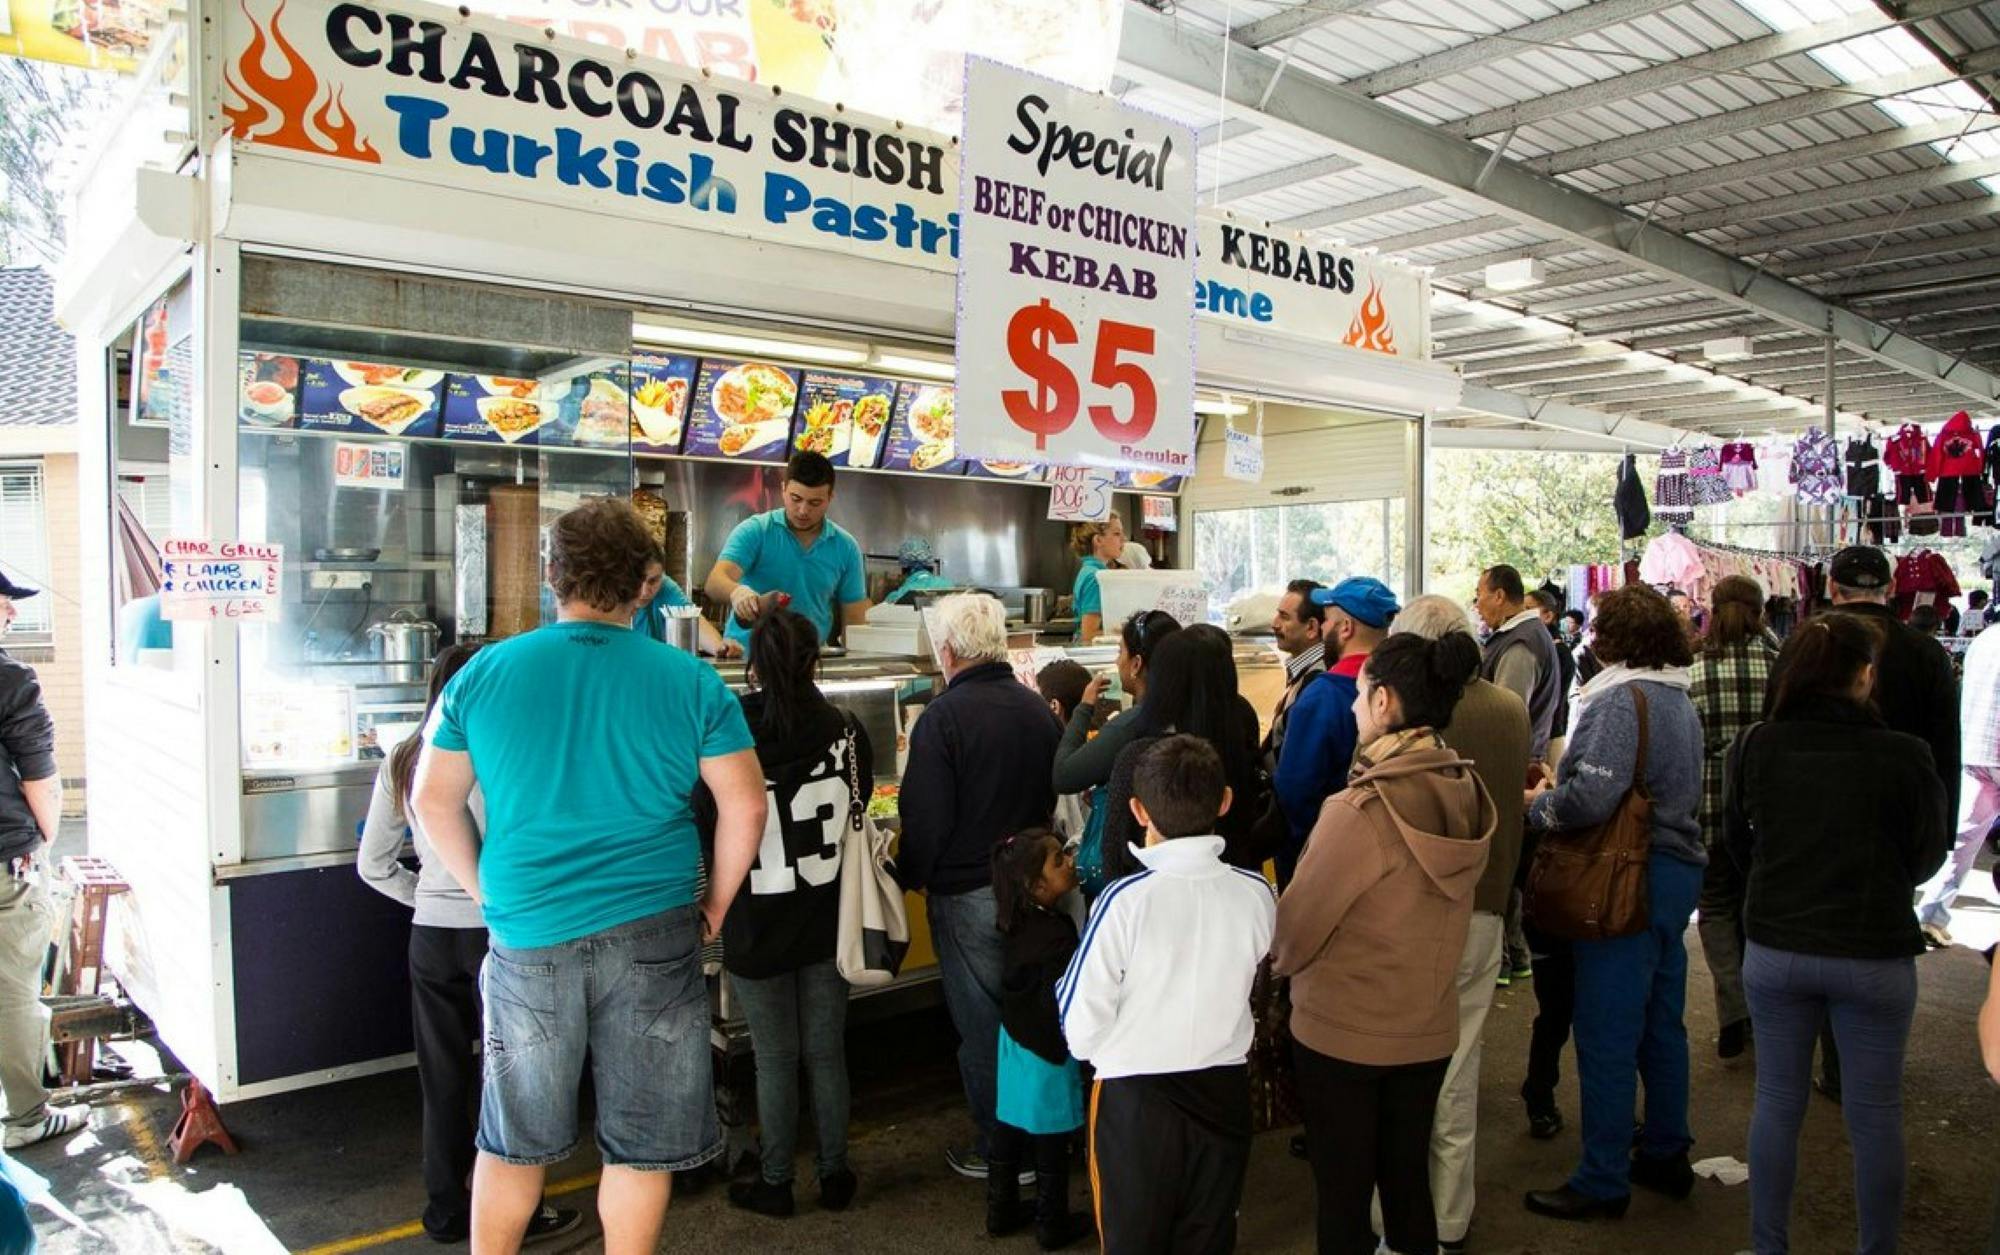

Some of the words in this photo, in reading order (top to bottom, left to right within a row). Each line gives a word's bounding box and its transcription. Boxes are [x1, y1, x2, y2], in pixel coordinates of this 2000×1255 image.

[326, 3, 752, 152] CHARCOAL
[772, 109, 944, 195] SHISH
[1221, 225, 1354, 294] KEBABS
[385, 94, 737, 214] Turkish
[1007, 94, 1173, 191] Special
[973, 175, 1046, 226] BEEF
[1047, 203, 1076, 233] or
[1078, 202, 1188, 260] CHICKEN
[1009, 241, 1158, 300] KEBAB
[1001, 298, 1158, 450] $5
[1056, 465, 1092, 482] HOT
[1120, 445, 1188, 467] Regular
[1053, 484, 1083, 508] DOG
[164, 541, 213, 555] CHAR
[220, 543, 278, 558] GRILL
[186, 563, 241, 579] LAMB
[182, 579, 262, 592] CHICKEN
[751, 776, 850, 895] 13
